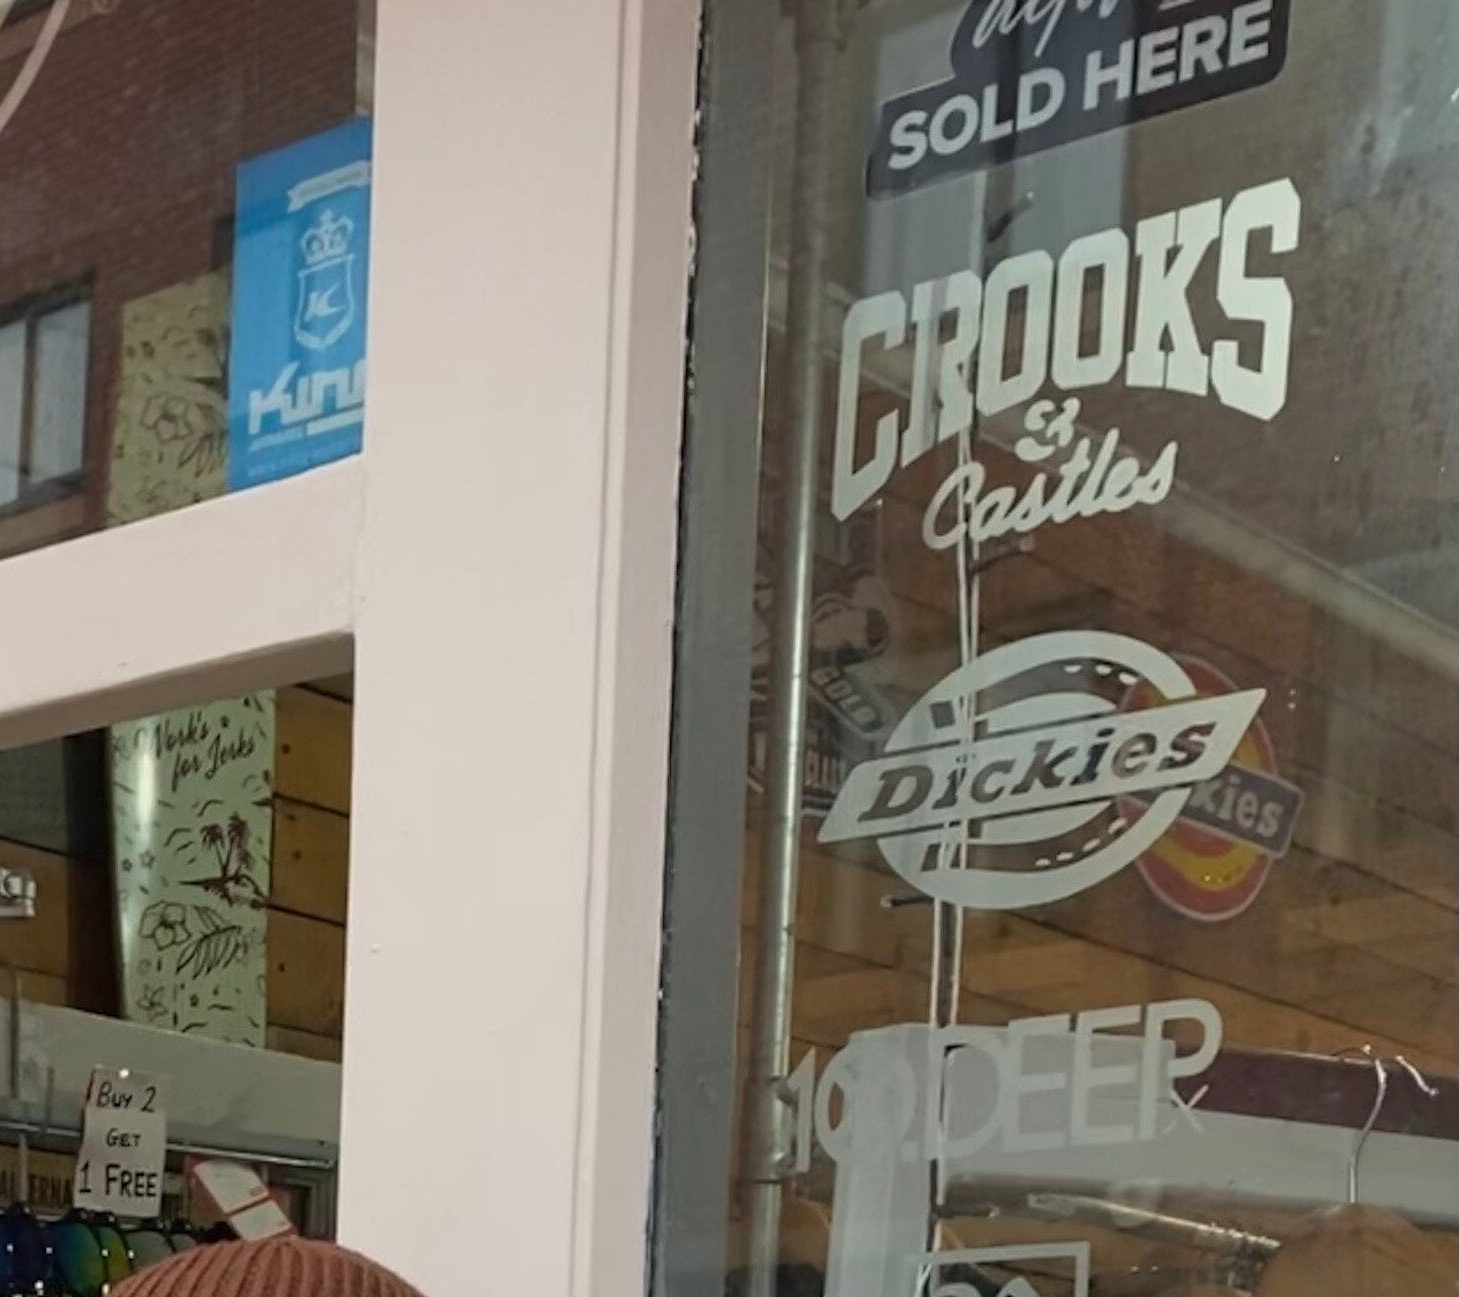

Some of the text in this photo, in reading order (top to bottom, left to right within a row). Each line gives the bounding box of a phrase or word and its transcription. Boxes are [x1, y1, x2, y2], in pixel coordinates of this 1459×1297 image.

[887, 67, 1066, 171] SOLD
[1083, 0, 1274, 111] HERE
[831, 177, 1301, 521] CROOKS
[921, 425, 1178, 550] Castles
[856, 721, 1217, 823] Dickies
[1188, 773, 1285, 838] kies
[140, 1086, 157, 1113] 2
[79, 1160, 159, 1199] 1 FREE
